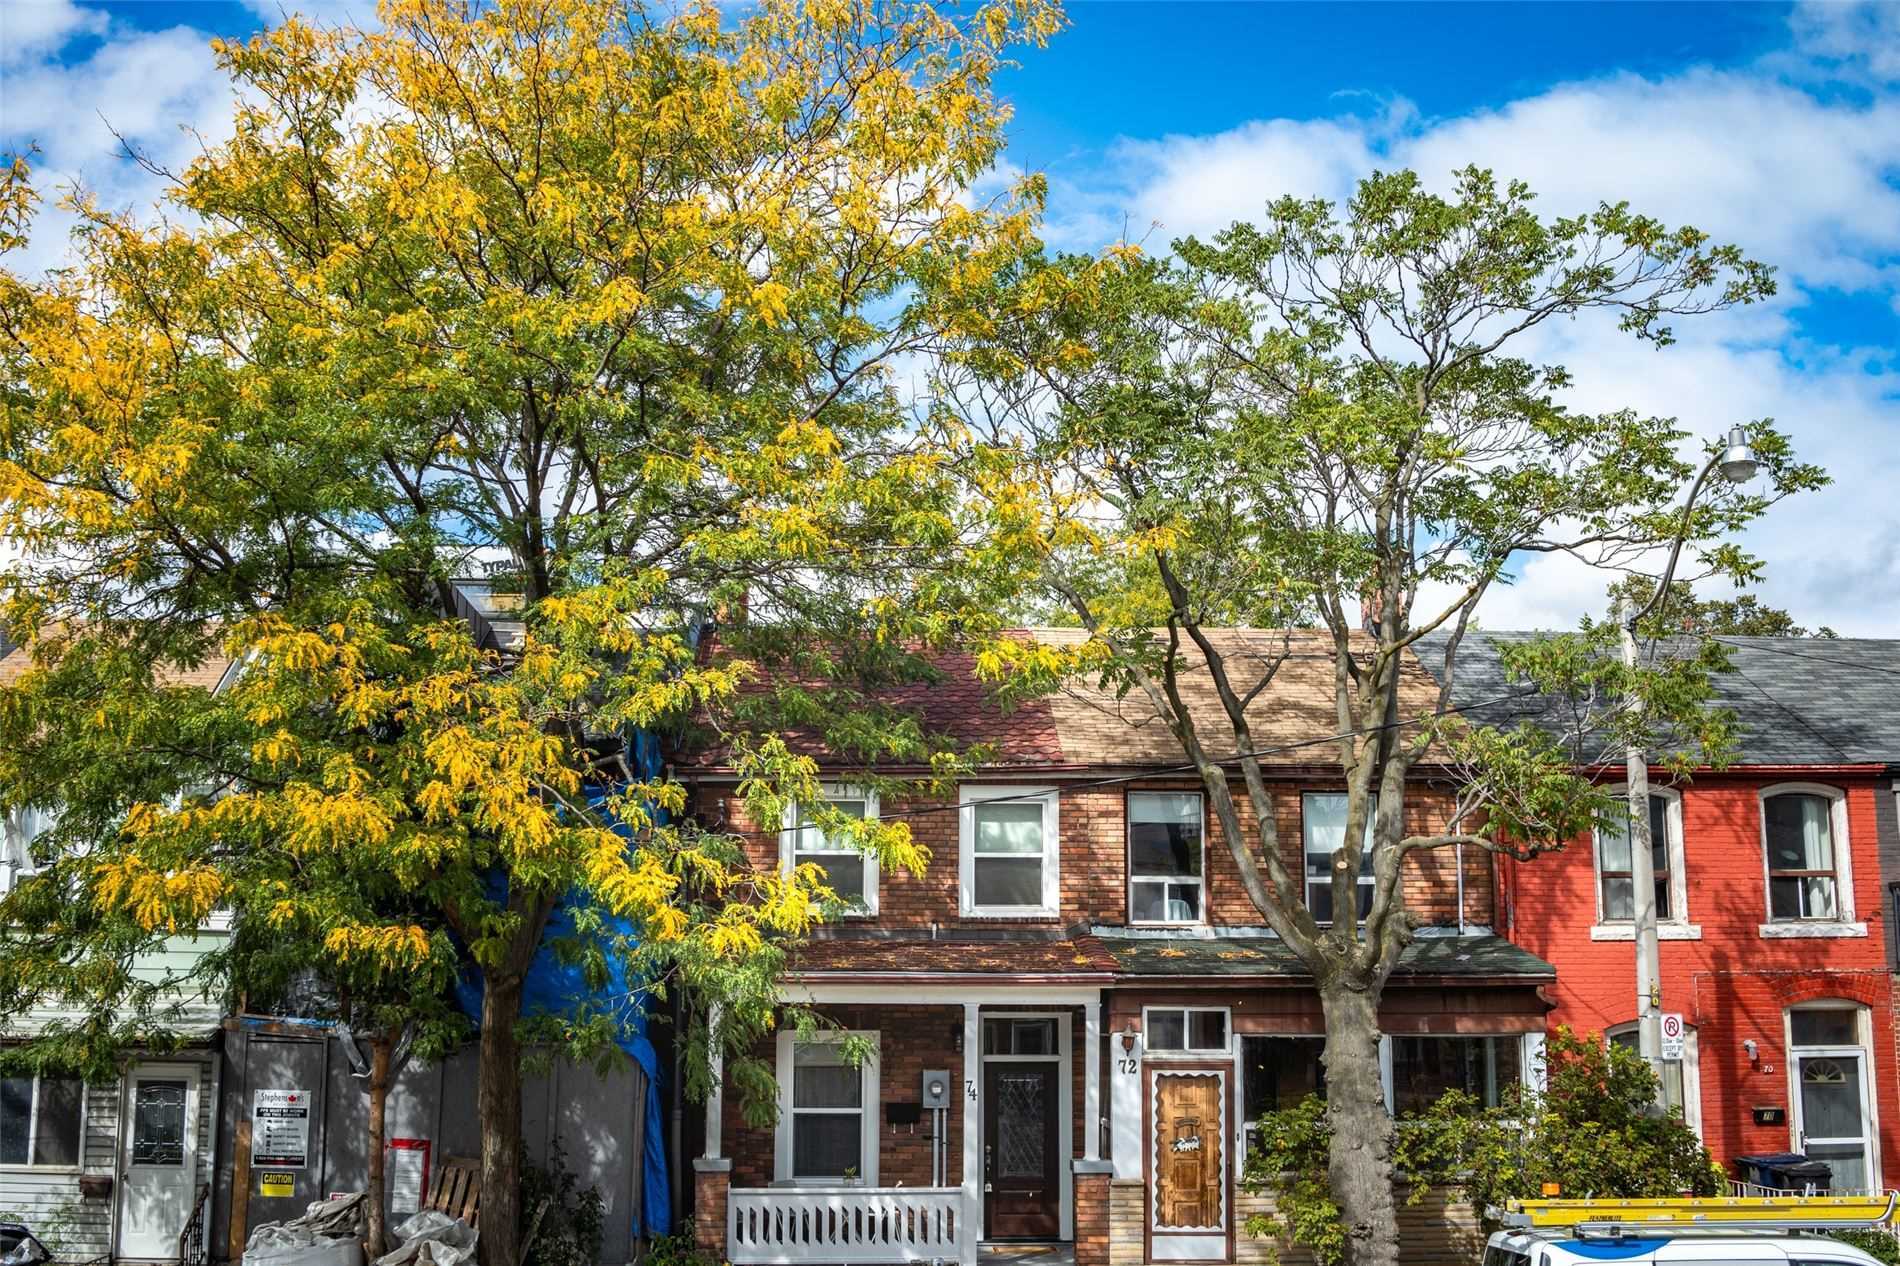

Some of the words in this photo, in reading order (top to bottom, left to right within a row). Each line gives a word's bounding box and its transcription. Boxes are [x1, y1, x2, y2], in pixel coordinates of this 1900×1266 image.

[1118, 1059, 1137, 1074] 72
[1763, 1065, 1774, 1073] 70
[965, 1080, 978, 1101] 74
[263, 1174, 293, 1184] CAUTION
